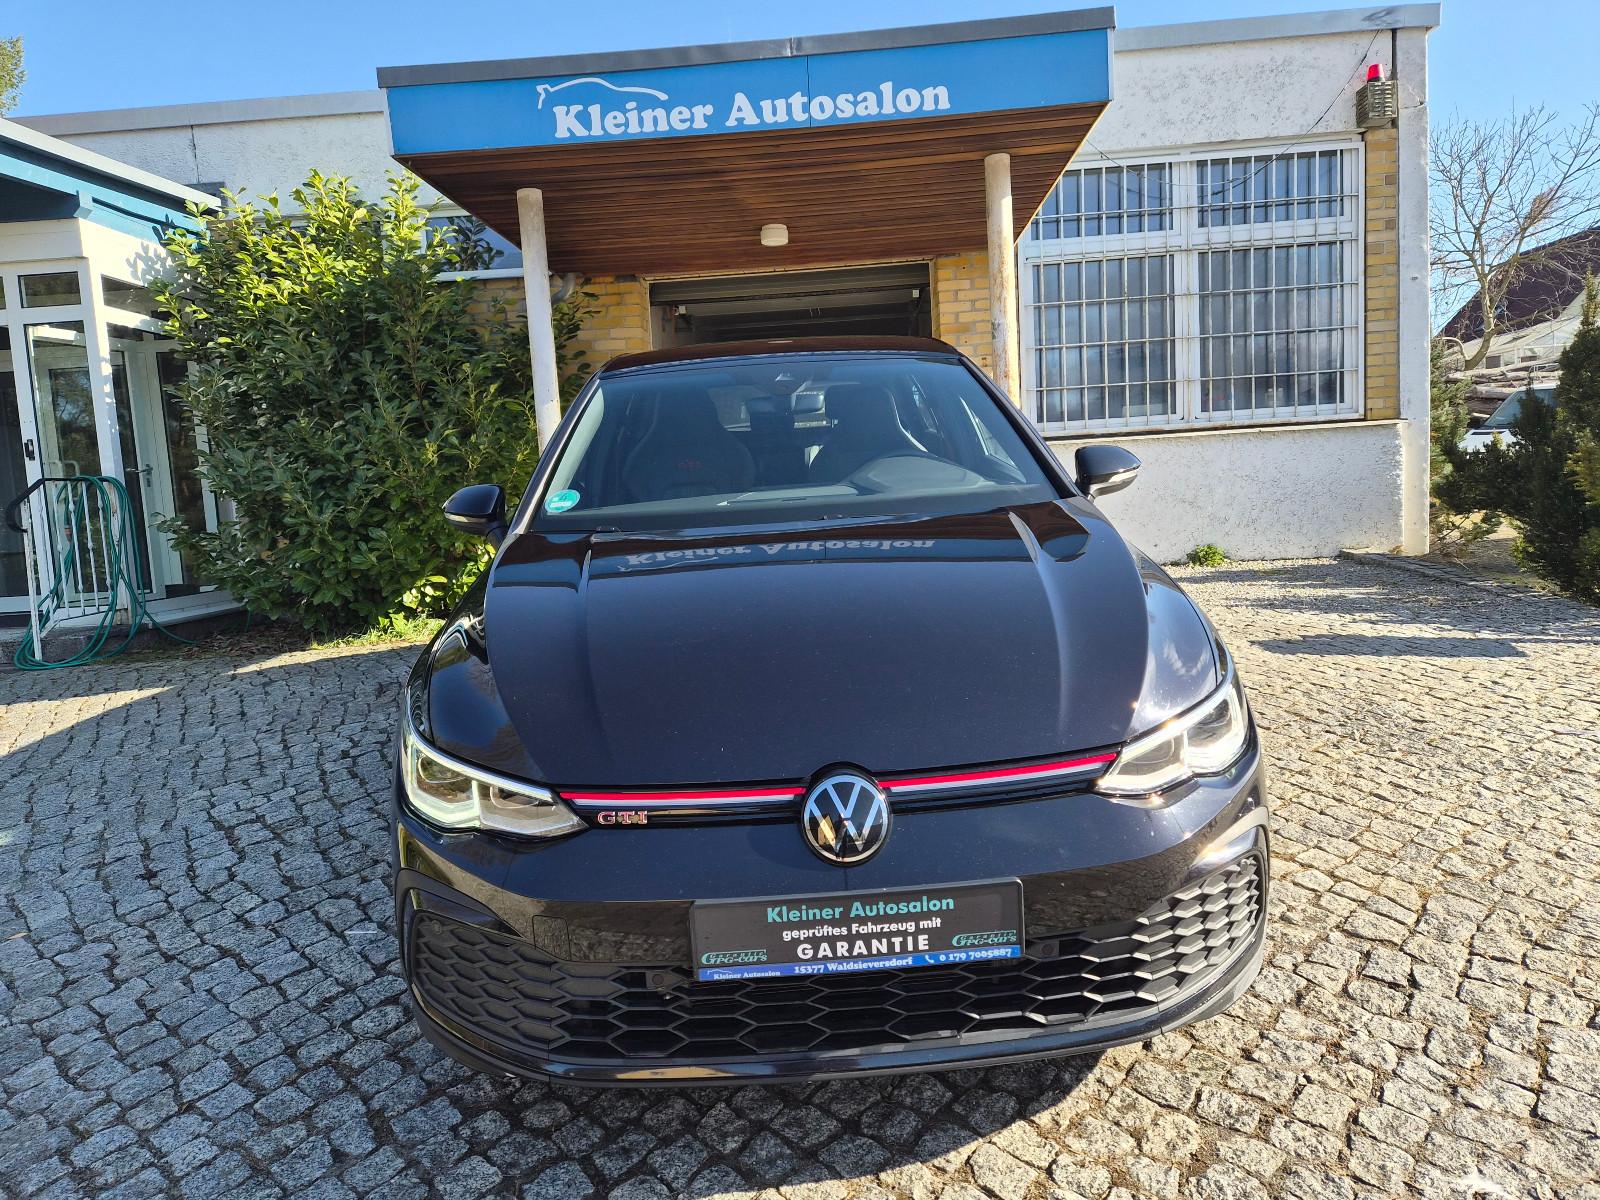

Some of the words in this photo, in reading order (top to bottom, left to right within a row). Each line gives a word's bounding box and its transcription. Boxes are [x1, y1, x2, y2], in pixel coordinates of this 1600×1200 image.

[552, 101, 713, 139] Kleiner
[725, 81, 951, 128] Autosalon
[597, 810, 649, 826] GTI
[767, 904, 843, 923] Kleiner
[850, 895, 955, 918] Autosalon
[782, 925, 848, 942] geprüftes
[851, 921, 916, 935] Fahrzeug
[919, 917, 942, 929] mit
[796, 934, 930, 960] GARANTIE
[713, 972, 741, 980] Kleiner
[742, 970, 781, 979] Autosalon
[794, 964, 825, 974] 15377
[826, 956, 913, 972] Waldsieversdorf
[939, 954, 947, 962] 0
[948, 952, 967, 961] 179
